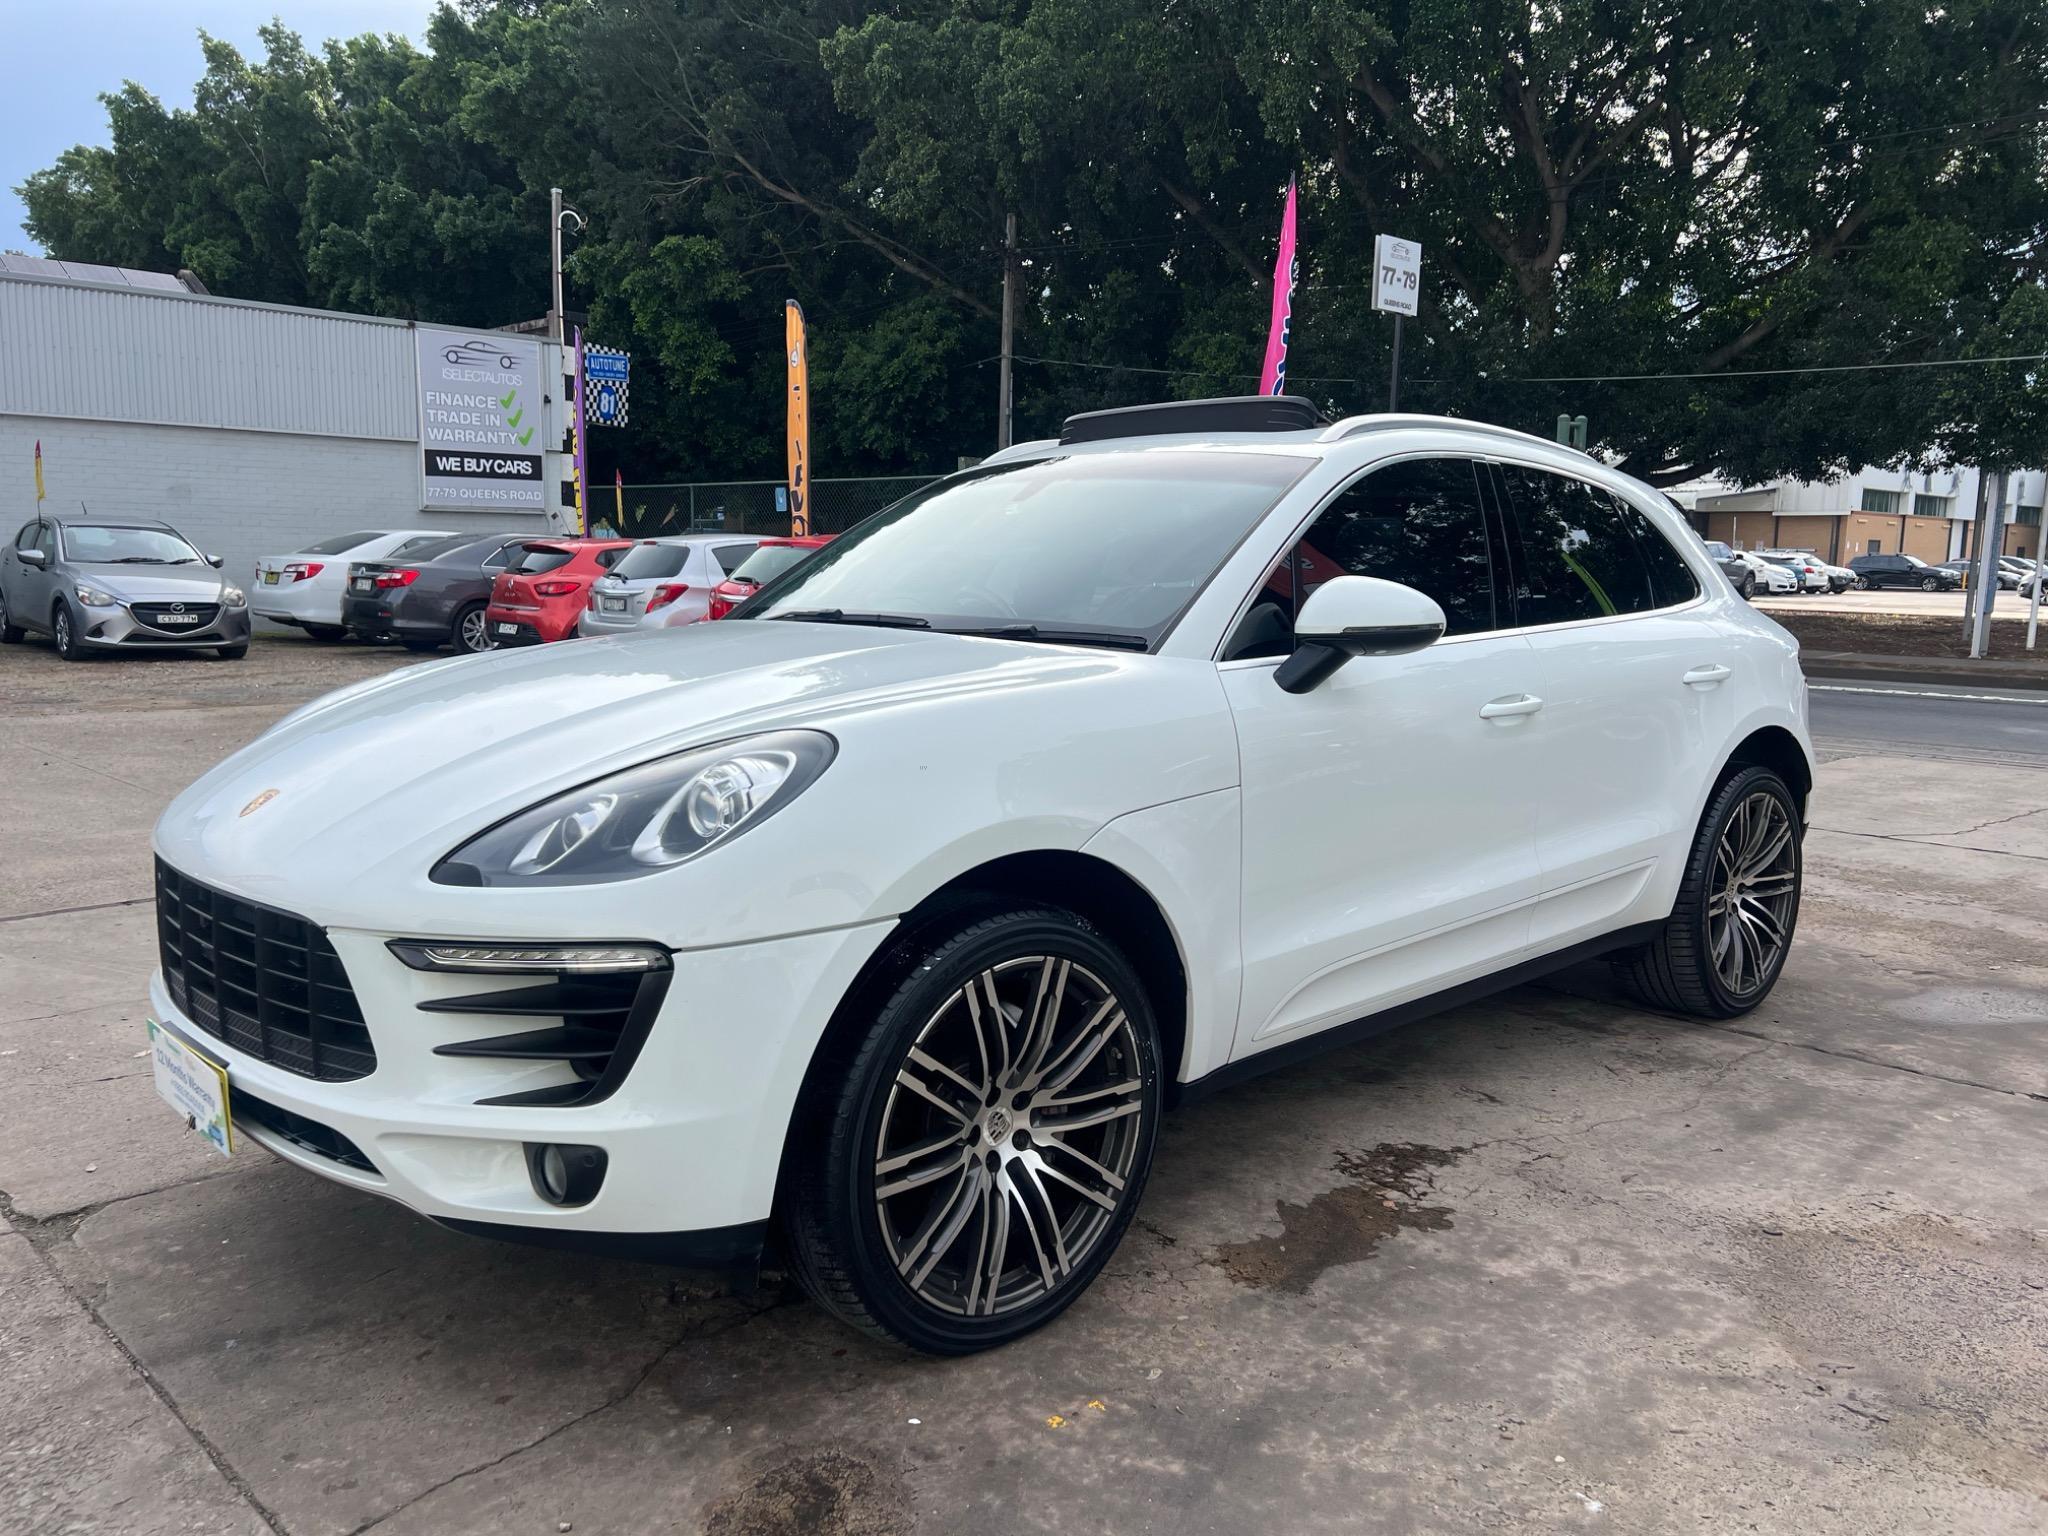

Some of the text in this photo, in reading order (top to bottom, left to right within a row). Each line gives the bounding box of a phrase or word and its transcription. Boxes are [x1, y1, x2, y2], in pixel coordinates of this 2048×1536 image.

[590, 357, 626, 372] AUTOTUNE
[426, 391, 497, 409] FINANCE
[600, 392, 615, 415] 81
[426, 409, 500, 427] TRADE IN
[427, 427, 518, 445] WARRANTY
[436, 456, 533, 475] WE BUY CARS
[428, 487, 542, 501] 77-79 QUEENS ROAD
